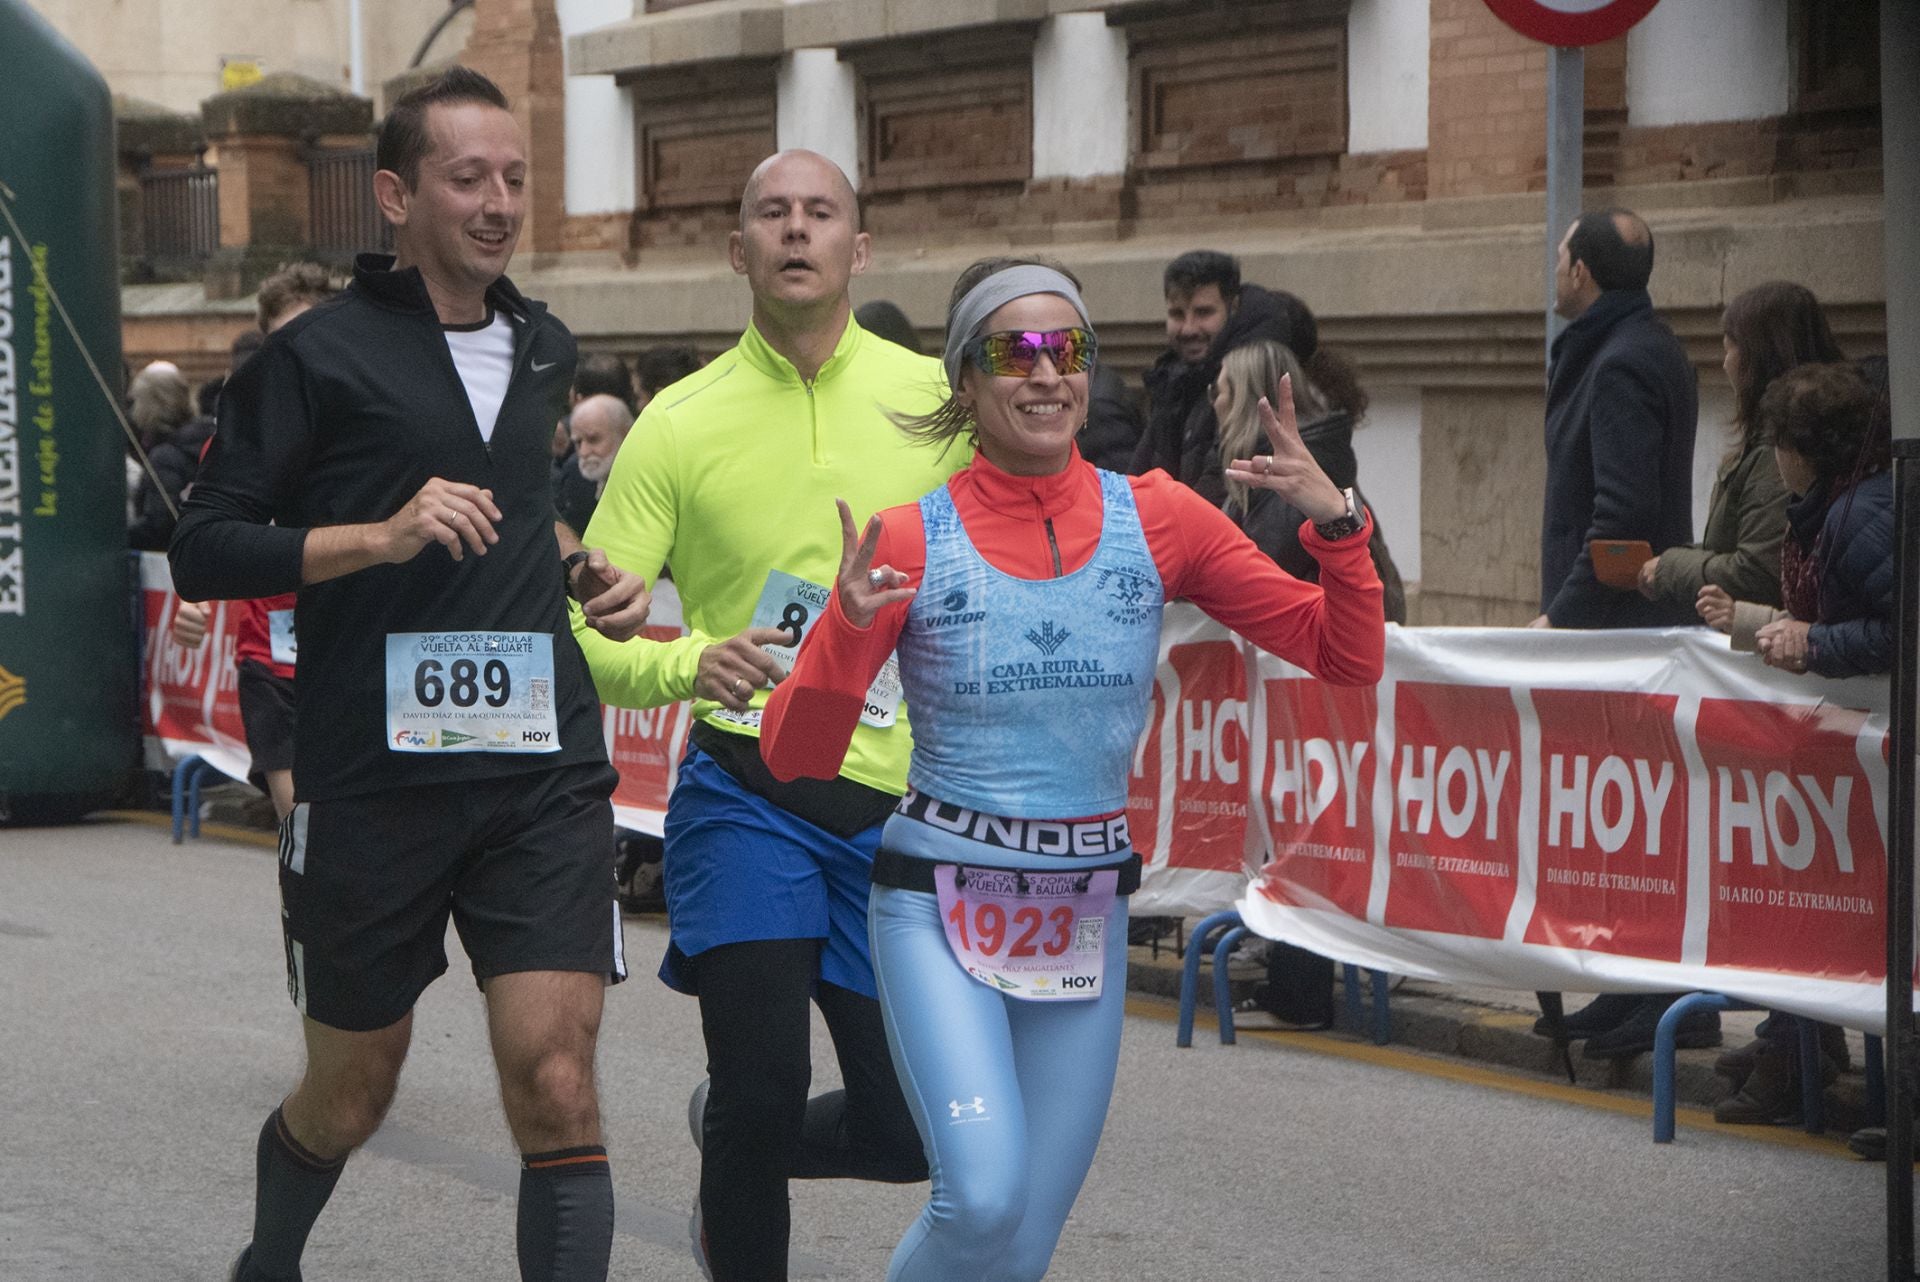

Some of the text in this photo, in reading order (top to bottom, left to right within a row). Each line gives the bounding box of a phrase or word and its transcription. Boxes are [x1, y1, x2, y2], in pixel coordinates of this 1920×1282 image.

[1096, 568, 1113, 591] CLUB
[797, 588, 829, 605] VUELT
[926, 611, 986, 628] VIATOR
[1107, 607, 1152, 625] BADAJOZ
[421, 643, 533, 653] VUELTA AL BALUARTE
[443, 634, 484, 643] CROSS
[487, 634, 533, 643] POPULAR
[992, 659, 1104, 679] CAJA RURAL
[414, 659, 511, 708] 689
[954, 674, 1134, 695] DE EXTREMADURA
[479, 712, 522, 720] QUINTANA
[522, 731, 551, 743] HOY
[1398, 744, 1511, 841] HOY
[1547, 754, 1674, 856] HOY
[1717, 765, 1855, 873] HOY
[1437, 856, 1510, 877] EXTREMADURA
[967, 879, 1013, 894] VUELTA
[1036, 884, 1087, 895] BALUAR
[993, 873, 1037, 885] CROS
[1039, 876, 1087, 886] POPULA
[1547, 867, 1676, 896] DIARIO DE EXTREMADURA
[1719, 885, 1875, 915] DIARIO DE EXTREMADURA
[949, 898, 1074, 958] 1923
[1062, 976, 1097, 989] HOY
